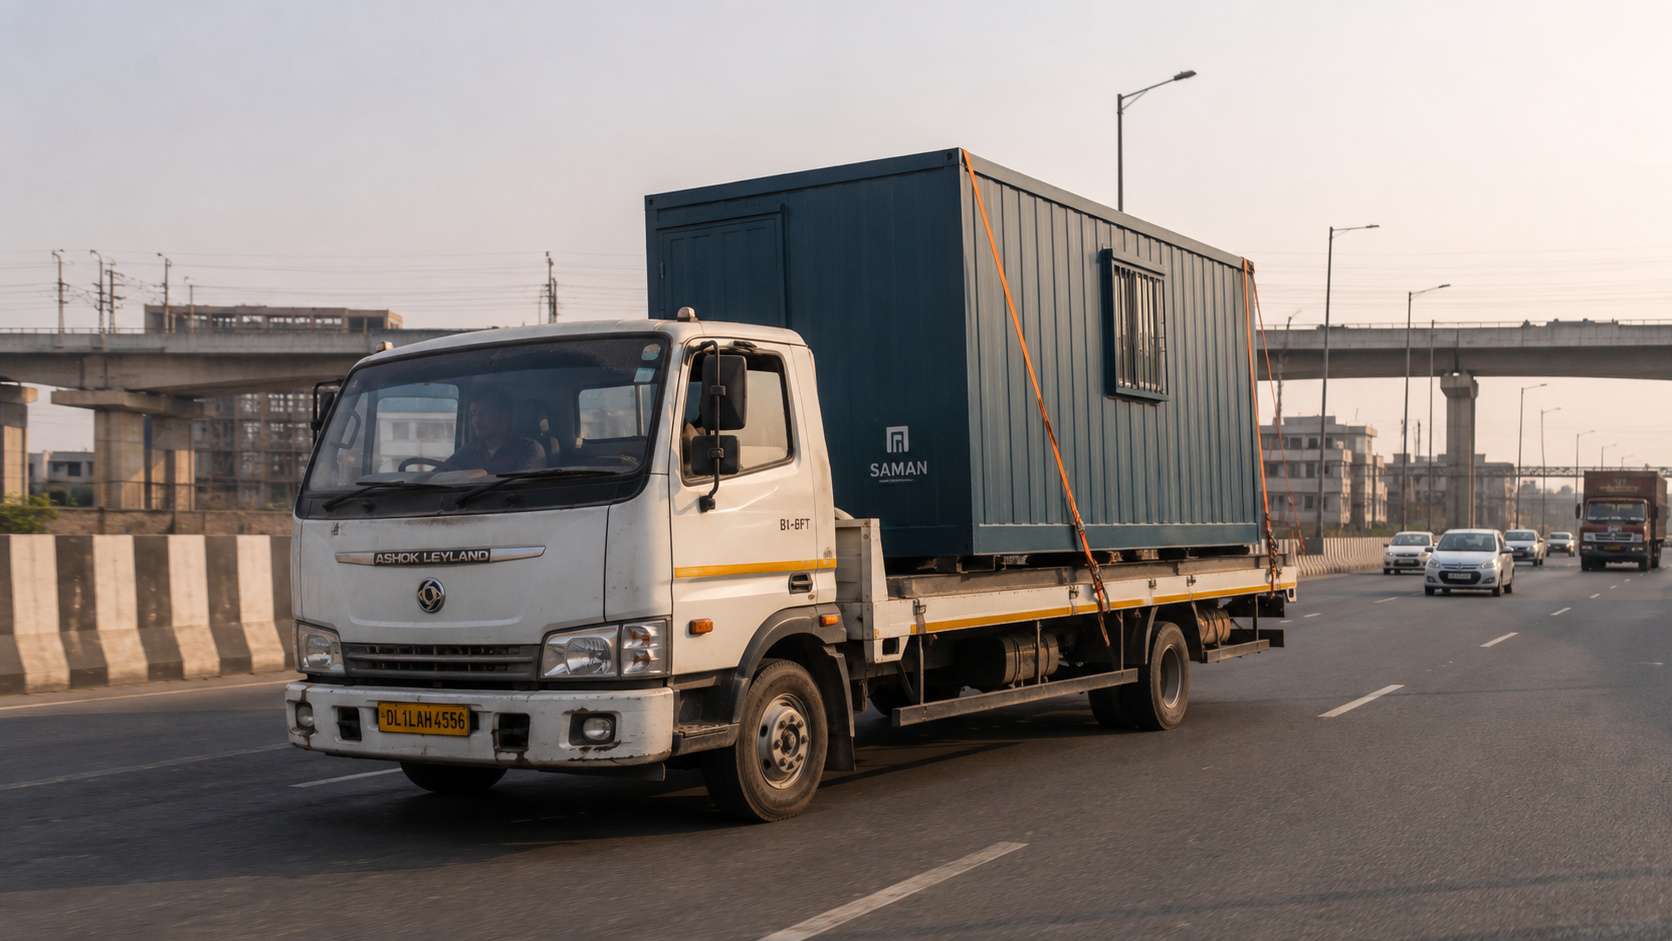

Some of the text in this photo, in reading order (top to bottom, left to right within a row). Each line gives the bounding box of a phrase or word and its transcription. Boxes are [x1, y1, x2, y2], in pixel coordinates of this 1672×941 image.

[870, 461, 927, 477] SAMAN
[375, 551, 488, 564] ASHOK LEYLAND
